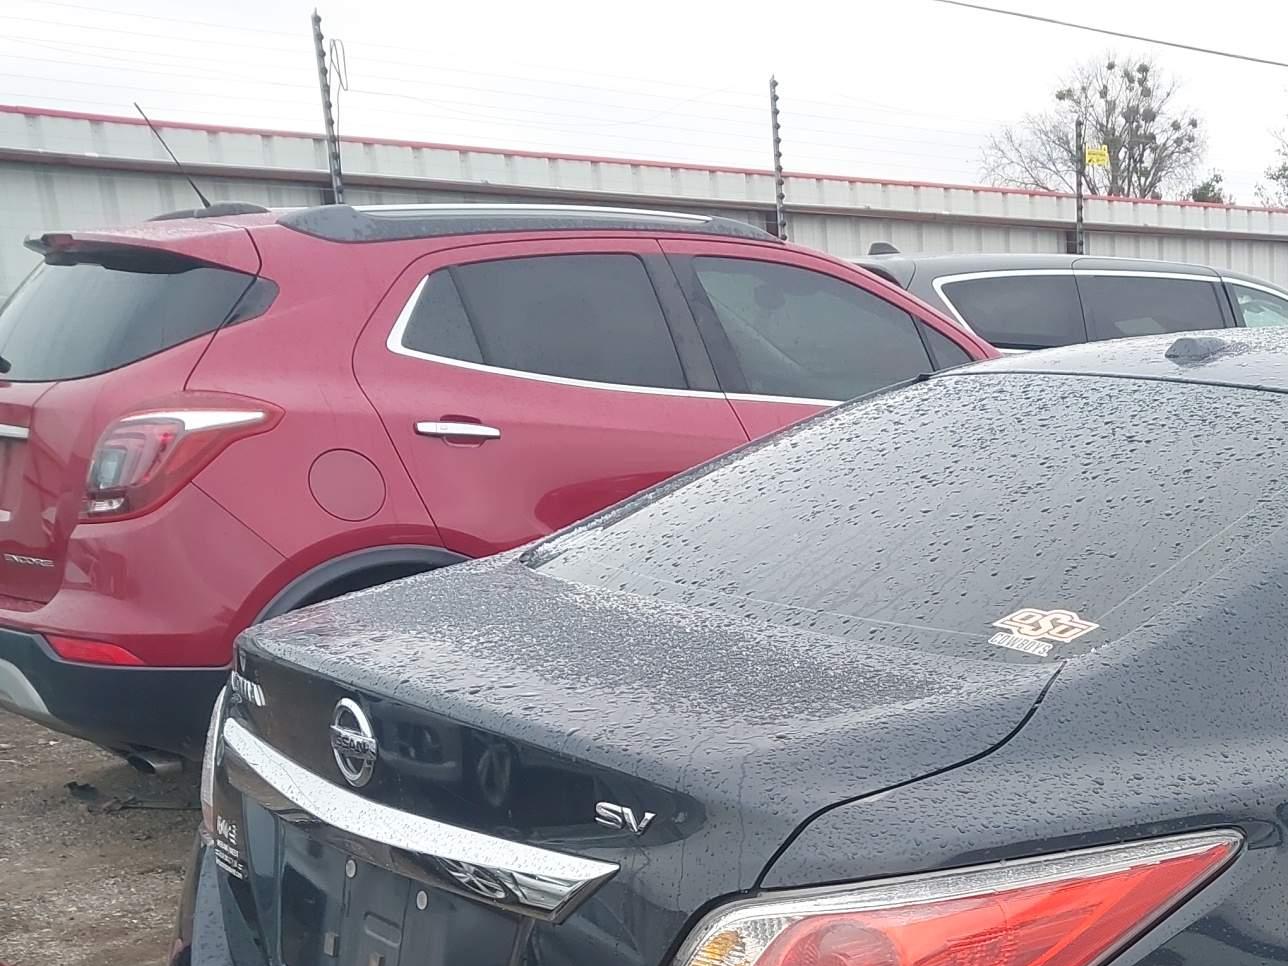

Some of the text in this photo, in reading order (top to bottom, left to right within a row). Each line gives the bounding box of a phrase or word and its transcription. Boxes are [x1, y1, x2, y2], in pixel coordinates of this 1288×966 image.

[4, 553, 55, 567] ENCORE
[989, 632, 1052, 656] COWBOYS
[595, 802, 657, 834] SV
